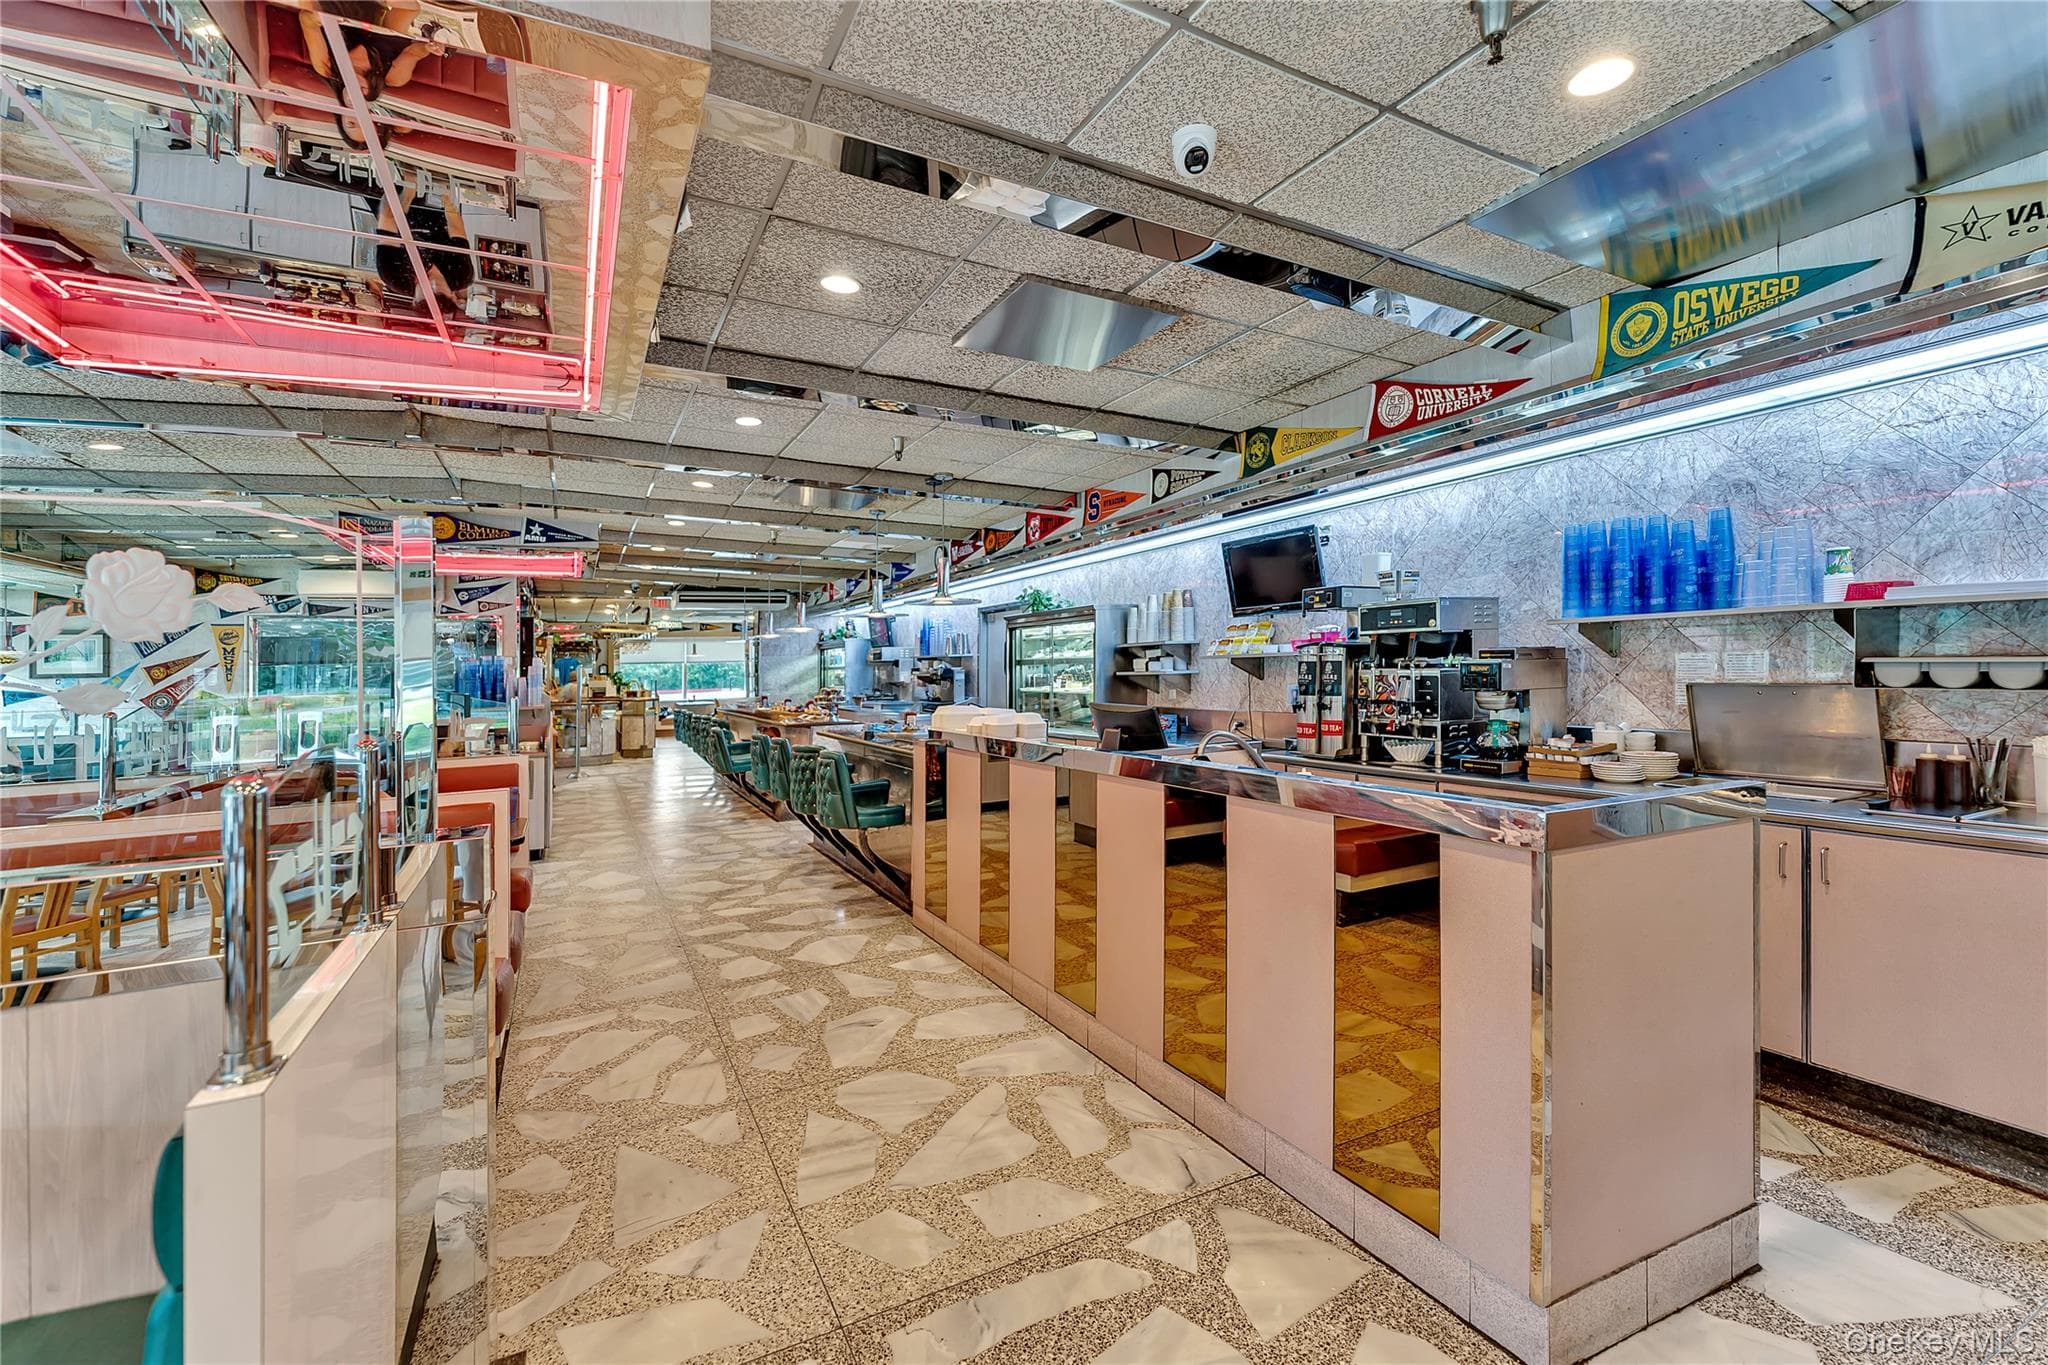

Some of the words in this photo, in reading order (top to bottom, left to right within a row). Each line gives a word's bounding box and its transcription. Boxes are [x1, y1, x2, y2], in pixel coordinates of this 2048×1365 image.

[2006, 201, 2048, 226] VA
[2008, 223, 2048, 237] CO
[1672, 275, 1801, 330] OSWEGO
[1670, 320, 1710, 349] STATE
[1714, 289, 1800, 330] UNIVERSITY
[1414, 384, 1493, 406] CORNELL
[1416, 391, 1493, 421] UNIVERSITY
[1280, 430, 1338, 456] CLARKSON
[1087, 491, 1102, 522] S
[364, 518, 394, 528] NAZARE
[524, 534, 547, 543] AMU
[222, 646, 237, 682] MSMC
